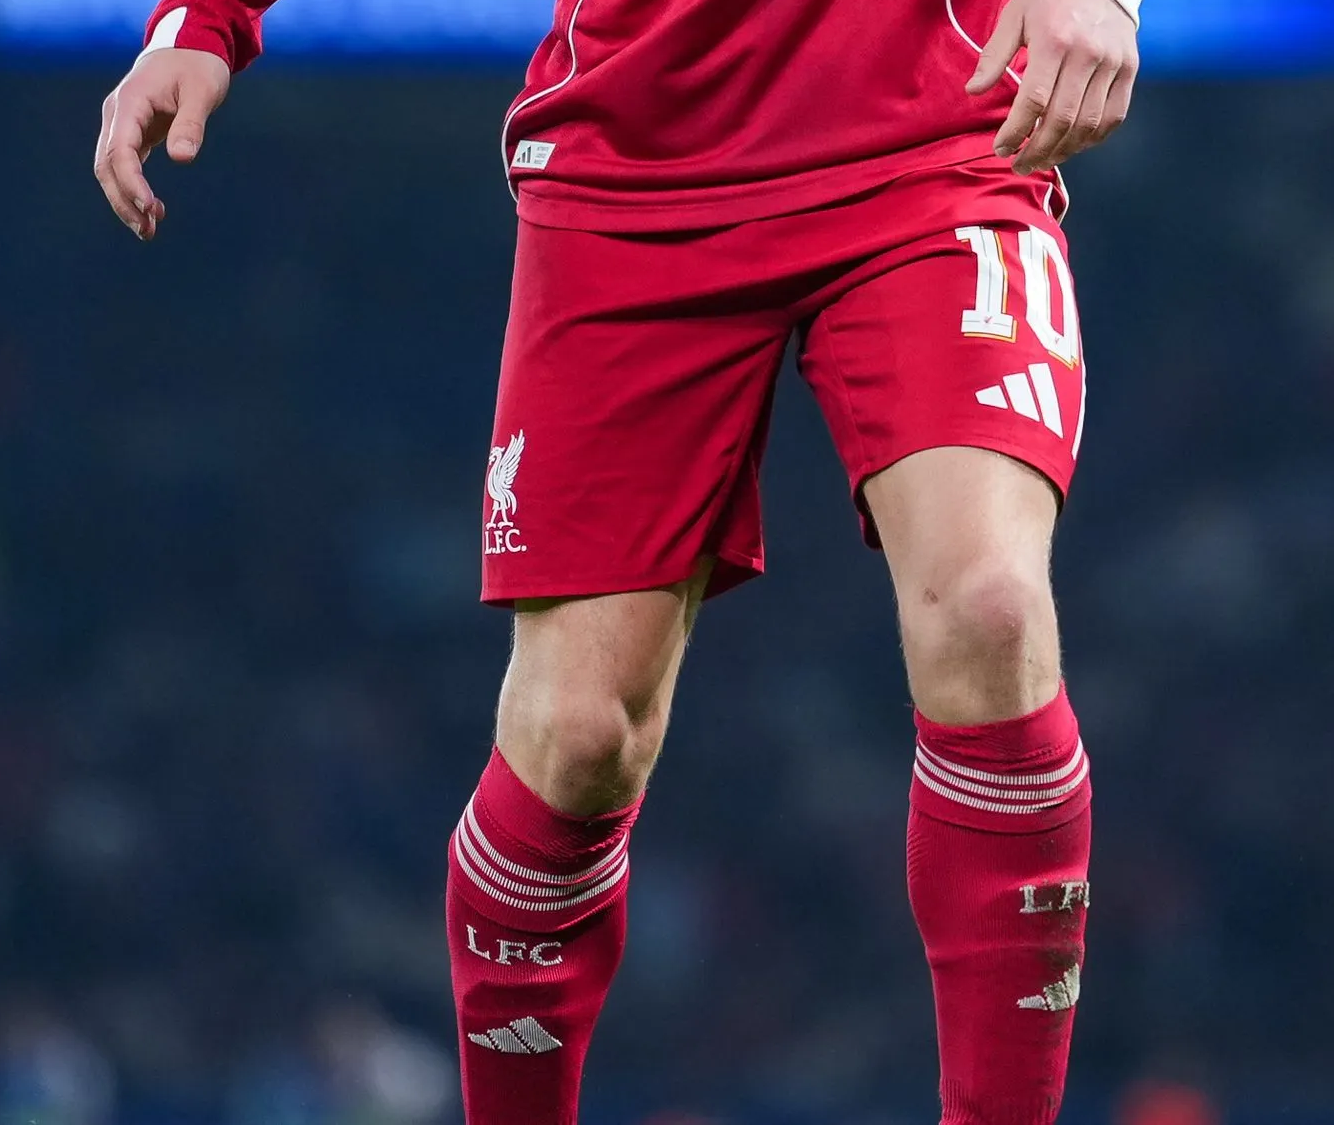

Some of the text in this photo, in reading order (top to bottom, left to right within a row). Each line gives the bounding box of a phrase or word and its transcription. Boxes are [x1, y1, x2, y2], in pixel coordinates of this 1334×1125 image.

[954, 224, 1080, 371] 10
[484, 529, 527, 555] L.F.C.
[466, 924, 563, 966] LFC
